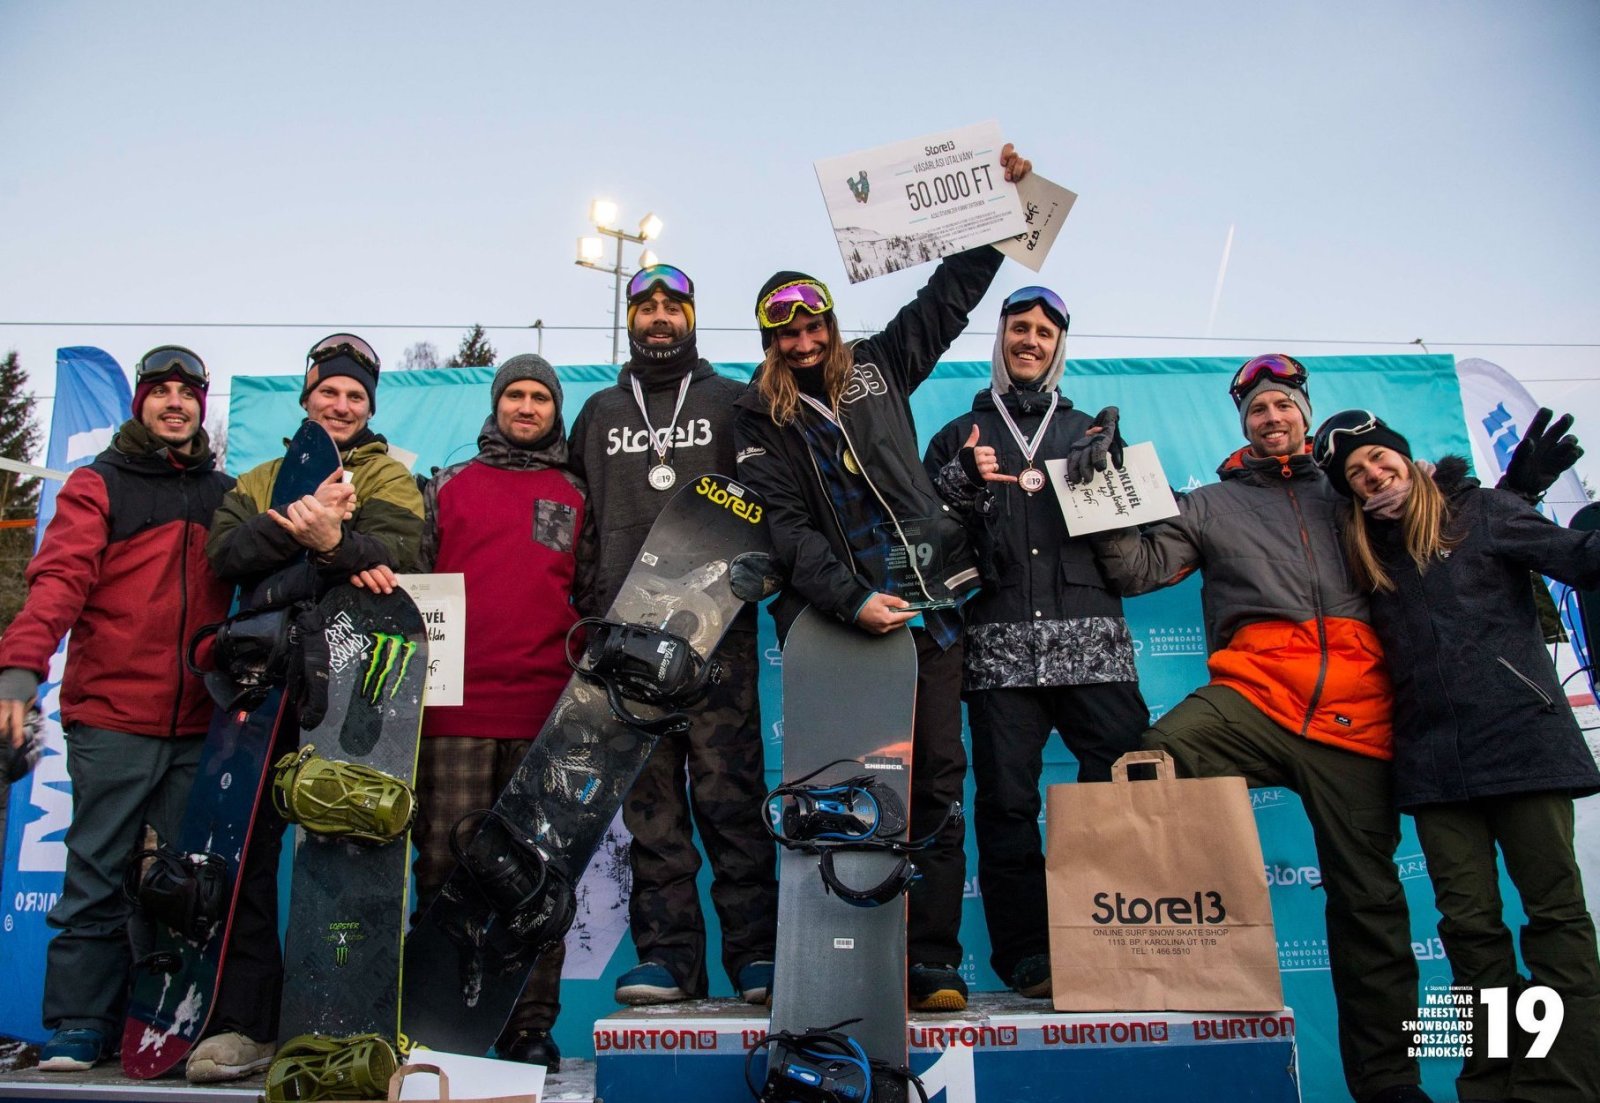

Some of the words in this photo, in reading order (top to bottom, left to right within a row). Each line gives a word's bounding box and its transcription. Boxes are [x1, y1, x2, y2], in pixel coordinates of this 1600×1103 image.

[924, 141, 956, 157] Store13
[905, 170, 971, 211] 50.000
[971, 164, 993, 194] FT
[695, 475, 763, 524] Store13
[1149, 626, 1201, 635] MAGYAR
[1150, 635, 1203, 644] SNOWBOARD
[1091, 890, 1226, 925] Store13
[1093, 929, 1123, 937] ONLINE
[1125, 929, 1147, 937] SURF
[1187, 937, 1198, 946] ÚT
[1279, 949, 1329, 957] NOWBOARD
[1281, 957, 1330, 967] ZÖVETSÉG
[908, 1026, 996, 1048] URTON
[1041, 1021, 1150, 1045] BURTON
[1192, 1016, 1294, 1041] BURTON
[594, 1029, 696, 1051] BURTON
